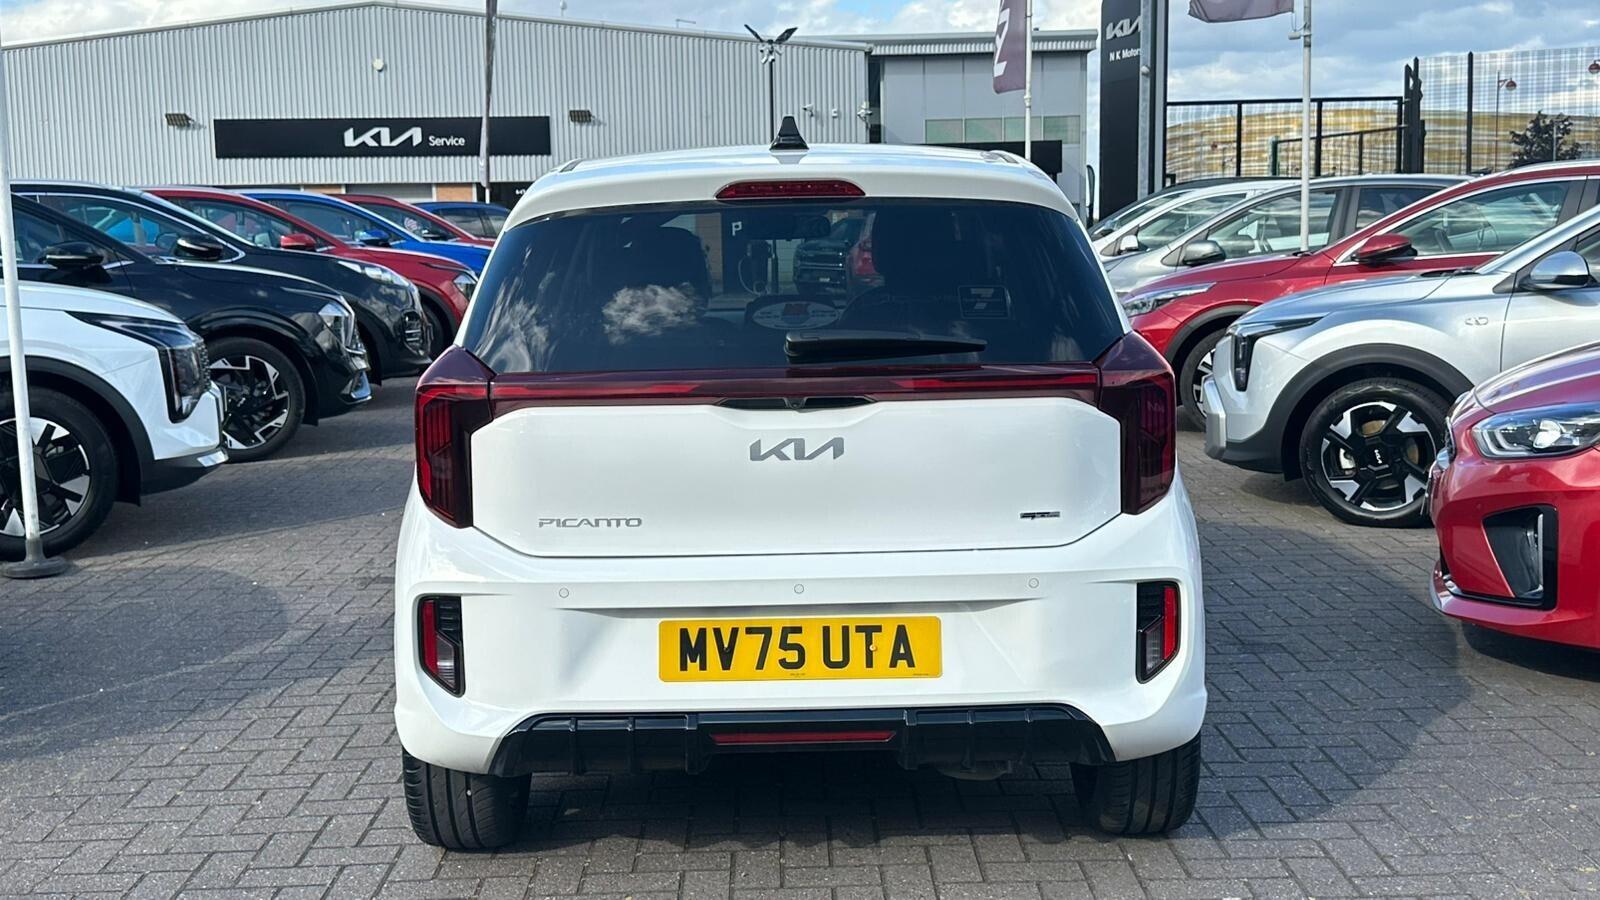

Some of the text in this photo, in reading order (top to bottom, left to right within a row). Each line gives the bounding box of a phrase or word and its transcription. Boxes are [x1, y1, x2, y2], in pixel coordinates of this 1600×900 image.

[1109, 51, 1115, 62] N
[1116, 50, 1121, 60] K
[344, 126, 466, 147] KIA Service
[731, 221, 743, 237] P
[749, 437, 844, 461] KIA
[538, 517, 643, 528] PICANTO
[679, 624, 916, 672] MV75 UTA
